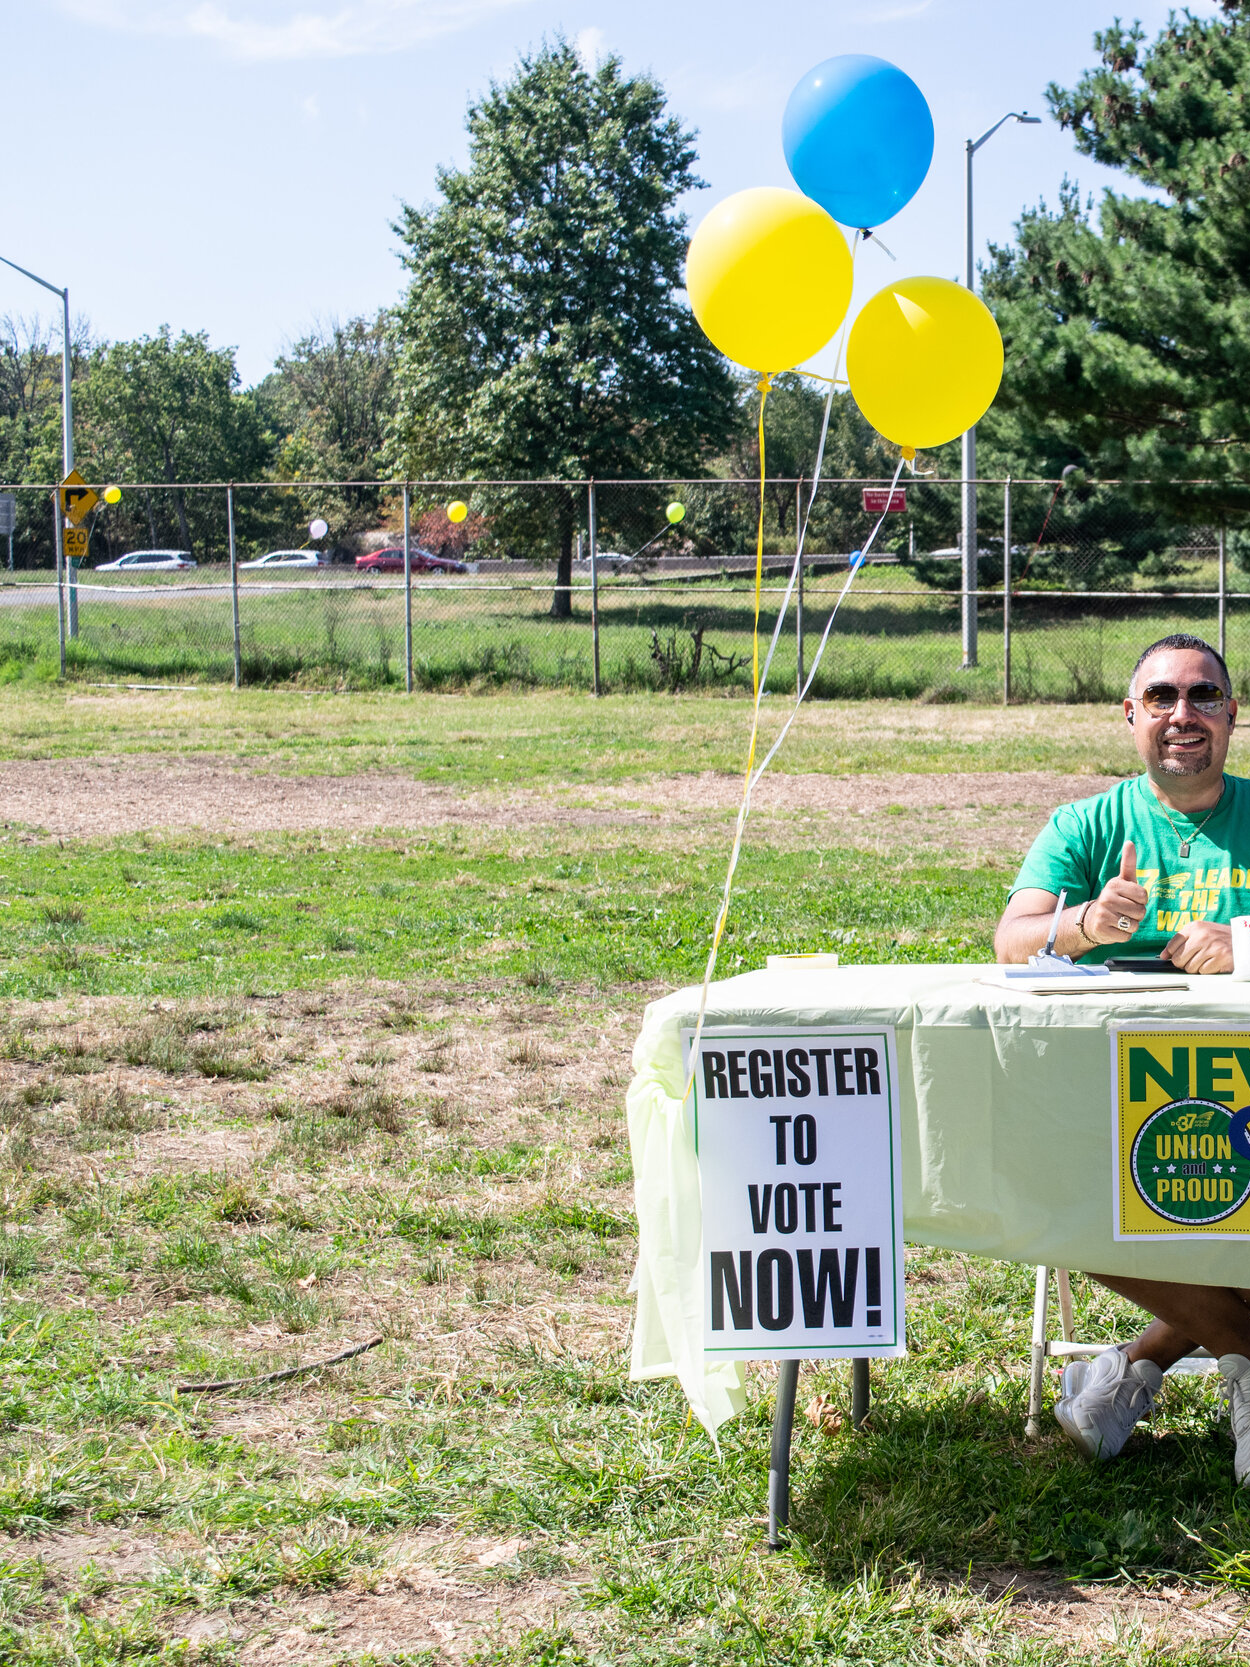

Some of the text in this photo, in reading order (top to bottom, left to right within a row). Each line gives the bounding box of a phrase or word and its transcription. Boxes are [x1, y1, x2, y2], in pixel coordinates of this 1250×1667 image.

[67, 531, 86, 544] 20
[1180, 889, 1220, 911] THE
[702, 1047, 881, 1099] REGISTER
[770, 1113, 817, 1166] TO
[1156, 1134, 1232, 1160] UNION
[1182, 1161, 1207, 1175] and
[1157, 1178, 1234, 1202] PROUD
[748, 1182, 842, 1234] VOTE
[710, 1247, 882, 1331] NOW!
